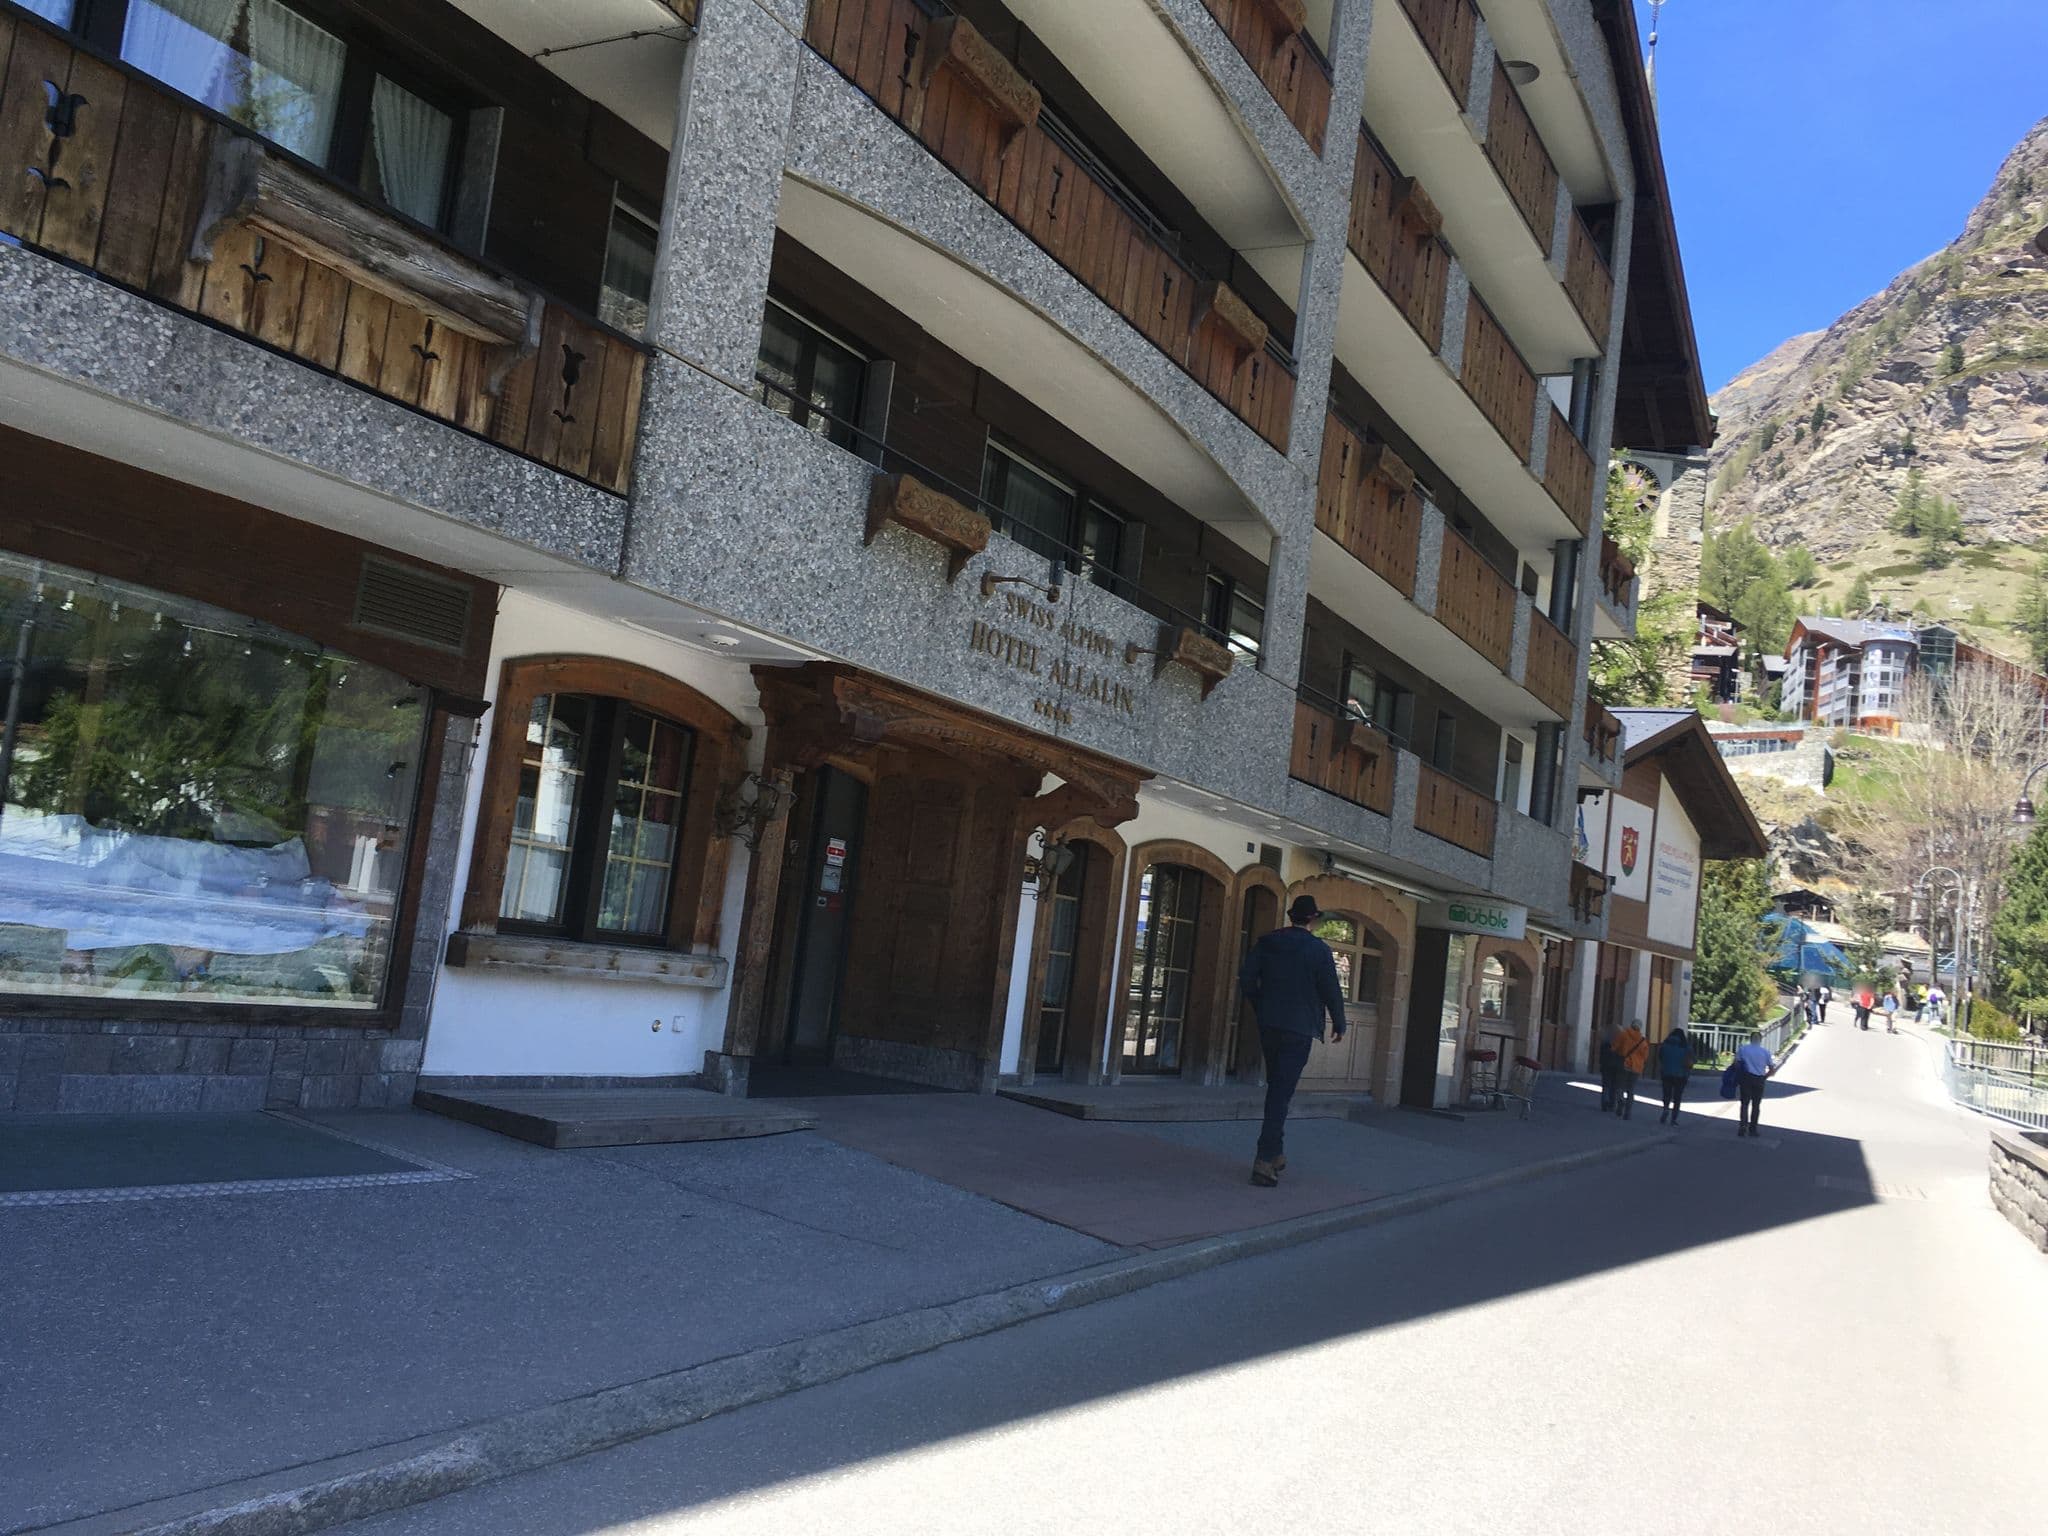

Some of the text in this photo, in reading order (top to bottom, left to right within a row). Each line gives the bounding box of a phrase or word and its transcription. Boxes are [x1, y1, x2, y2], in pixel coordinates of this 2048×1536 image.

[1006, 591, 1114, 657] SWISS ALPINE
[970, 620, 1134, 715] HOTEL ALLALIN
